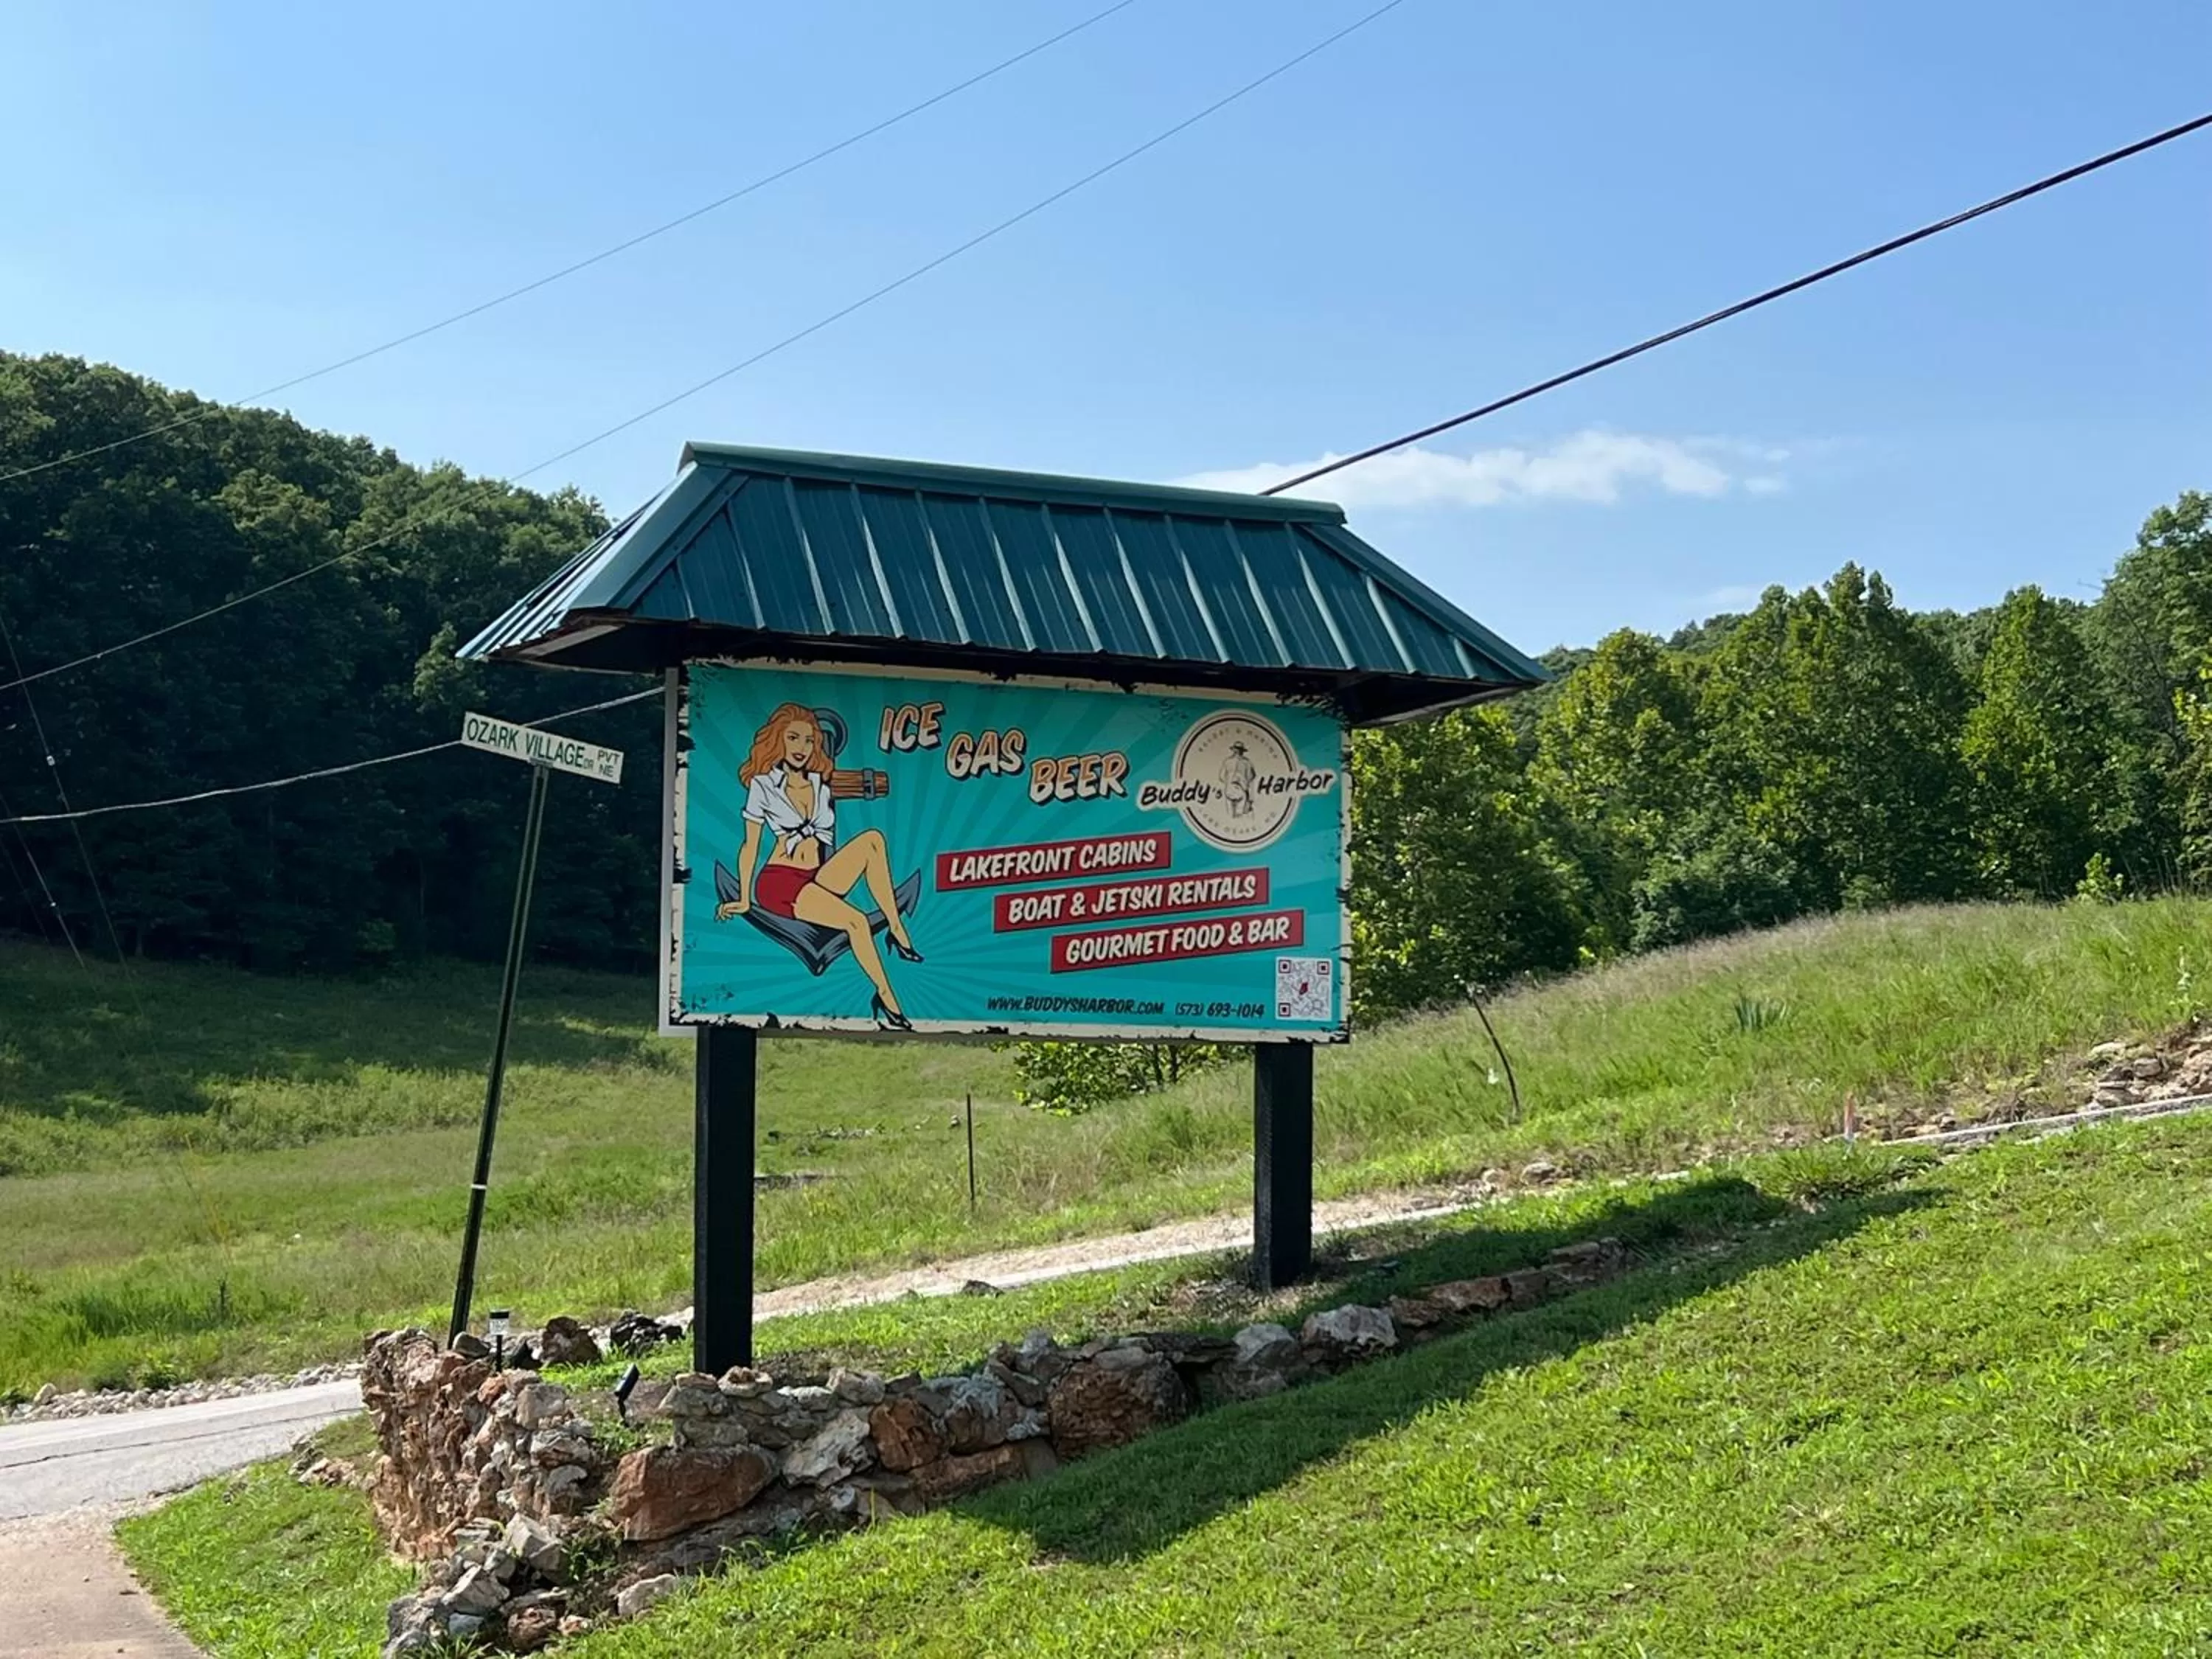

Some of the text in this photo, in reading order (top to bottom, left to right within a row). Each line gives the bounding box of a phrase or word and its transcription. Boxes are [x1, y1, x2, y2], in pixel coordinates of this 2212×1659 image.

[467, 718, 518, 751] OZARK
[525, 733, 585, 768] VILLAGE
[597, 749, 620, 765] PVT
[879, 702, 1130, 806] ICE GAS BEER
[599, 764, 614, 777] NE
[1141, 771, 1333, 805] Buddy's Harbor
[949, 839, 1158, 883] LAKEFRONT CABINS
[1008, 875, 1256, 923] BOAT & JETSKI RENTALS
[1065, 916, 1290, 964] GOURMET FOOD & BAR
[987, 996, 1265, 1018] WWW.BUDDYSHARBOR.COM (573) 693-1014
